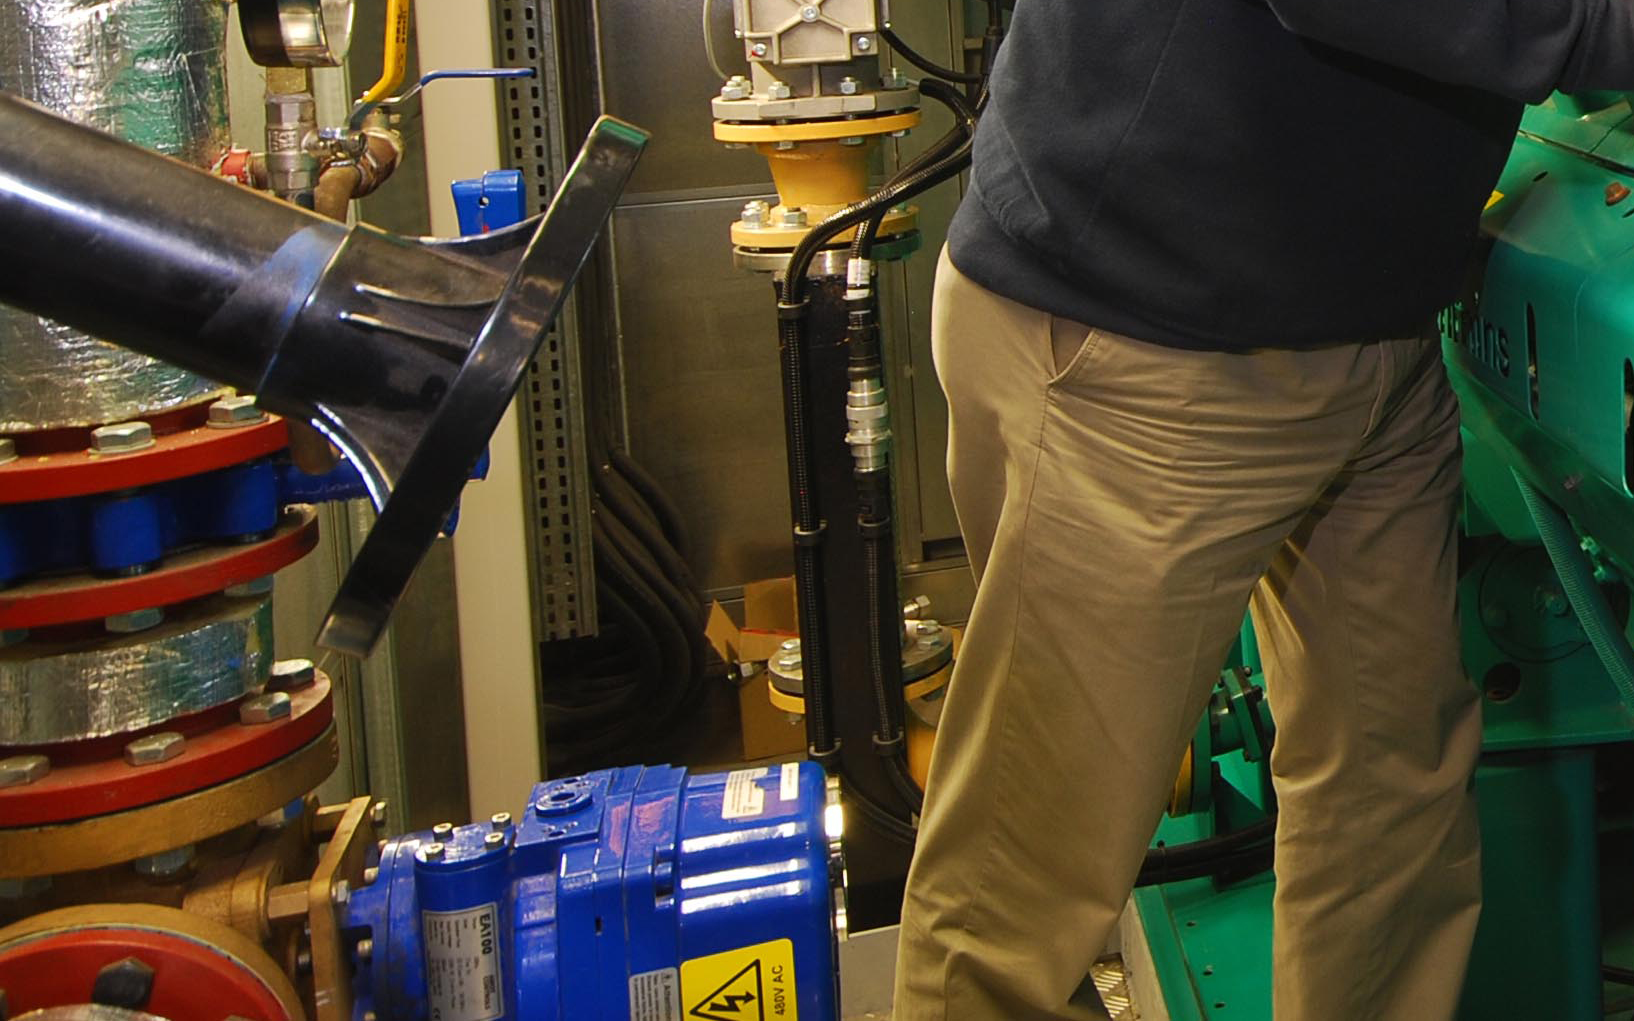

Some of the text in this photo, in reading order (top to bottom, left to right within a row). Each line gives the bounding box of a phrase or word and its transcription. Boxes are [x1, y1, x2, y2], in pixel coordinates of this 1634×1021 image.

[479, 913, 493, 955] EA100
[771, 964, 786, 1016] 480V AC
